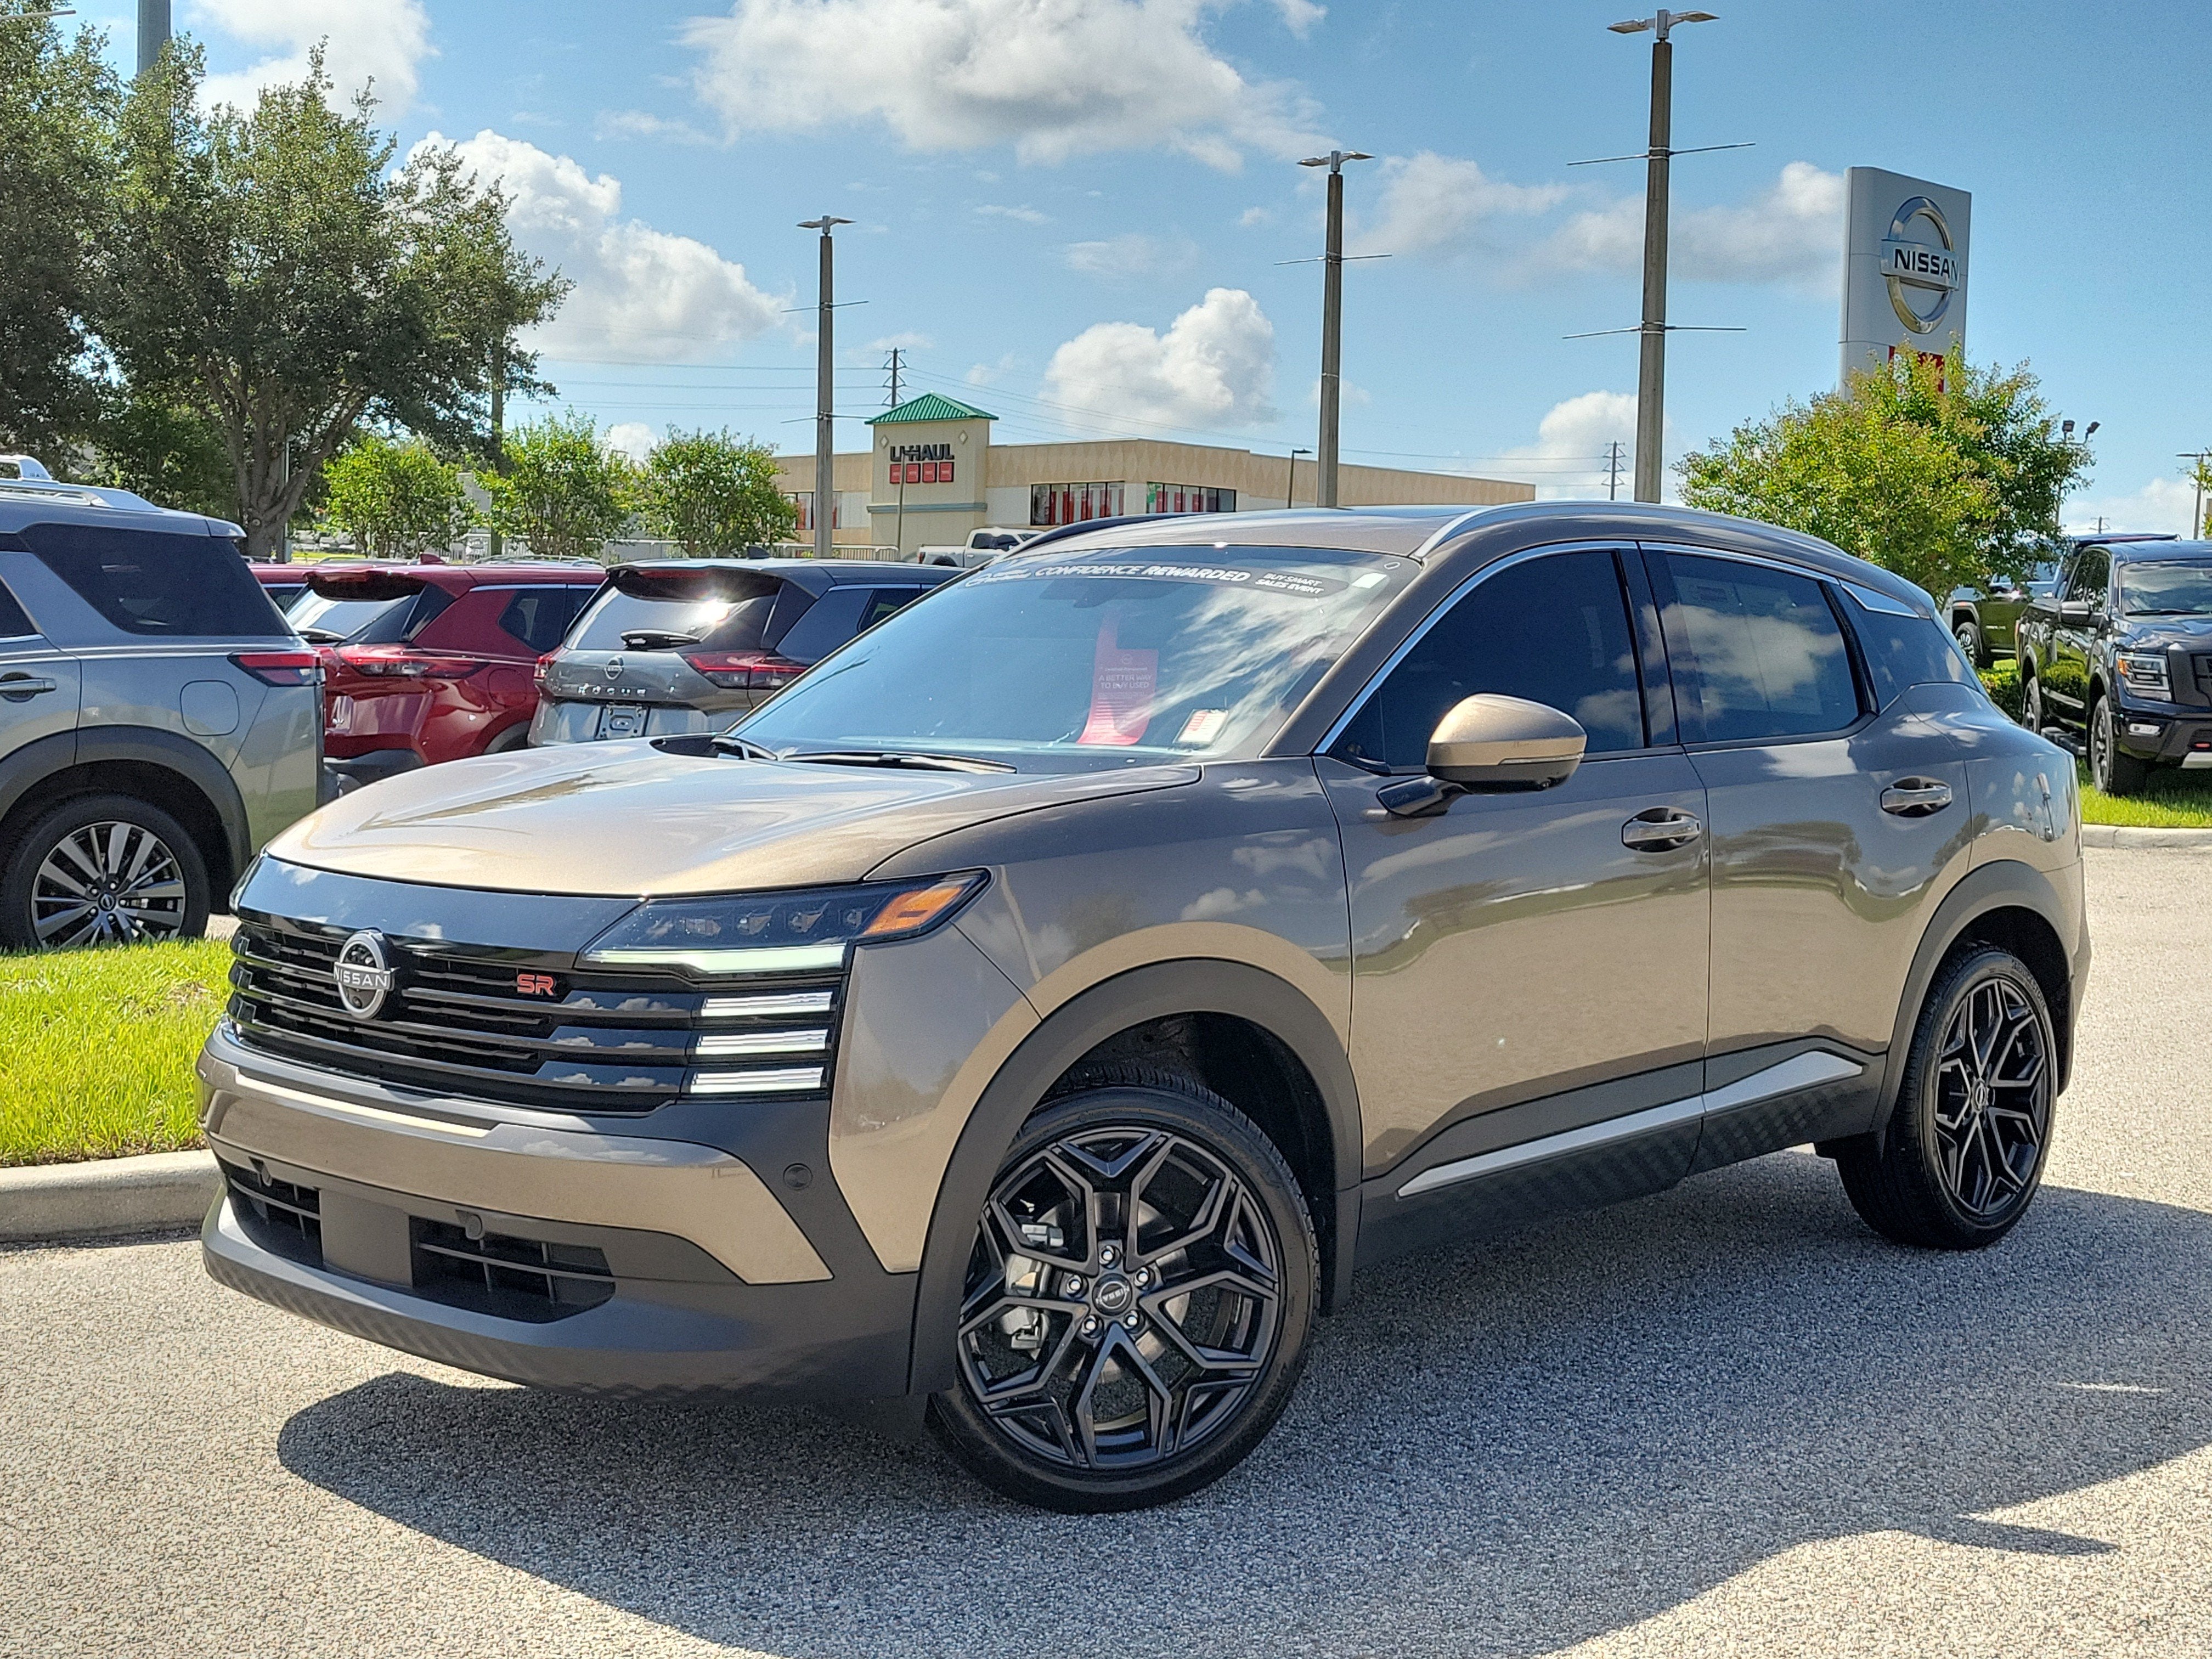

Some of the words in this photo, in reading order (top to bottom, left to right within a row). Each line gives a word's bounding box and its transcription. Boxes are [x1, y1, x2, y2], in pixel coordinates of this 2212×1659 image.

[1894, 248, 1959, 281] NISSAN
[1035, 565, 1145, 577] CONFIDENCE
[1141, 565, 1251, 582] REWARDED
[1284, 575, 1323, 587] SMART
[1255, 579, 1289, 589] SALES
[1286, 583, 1324, 594] EVENT
[334, 966, 387, 987] NISSAN
[517, 974, 555, 996] SR
